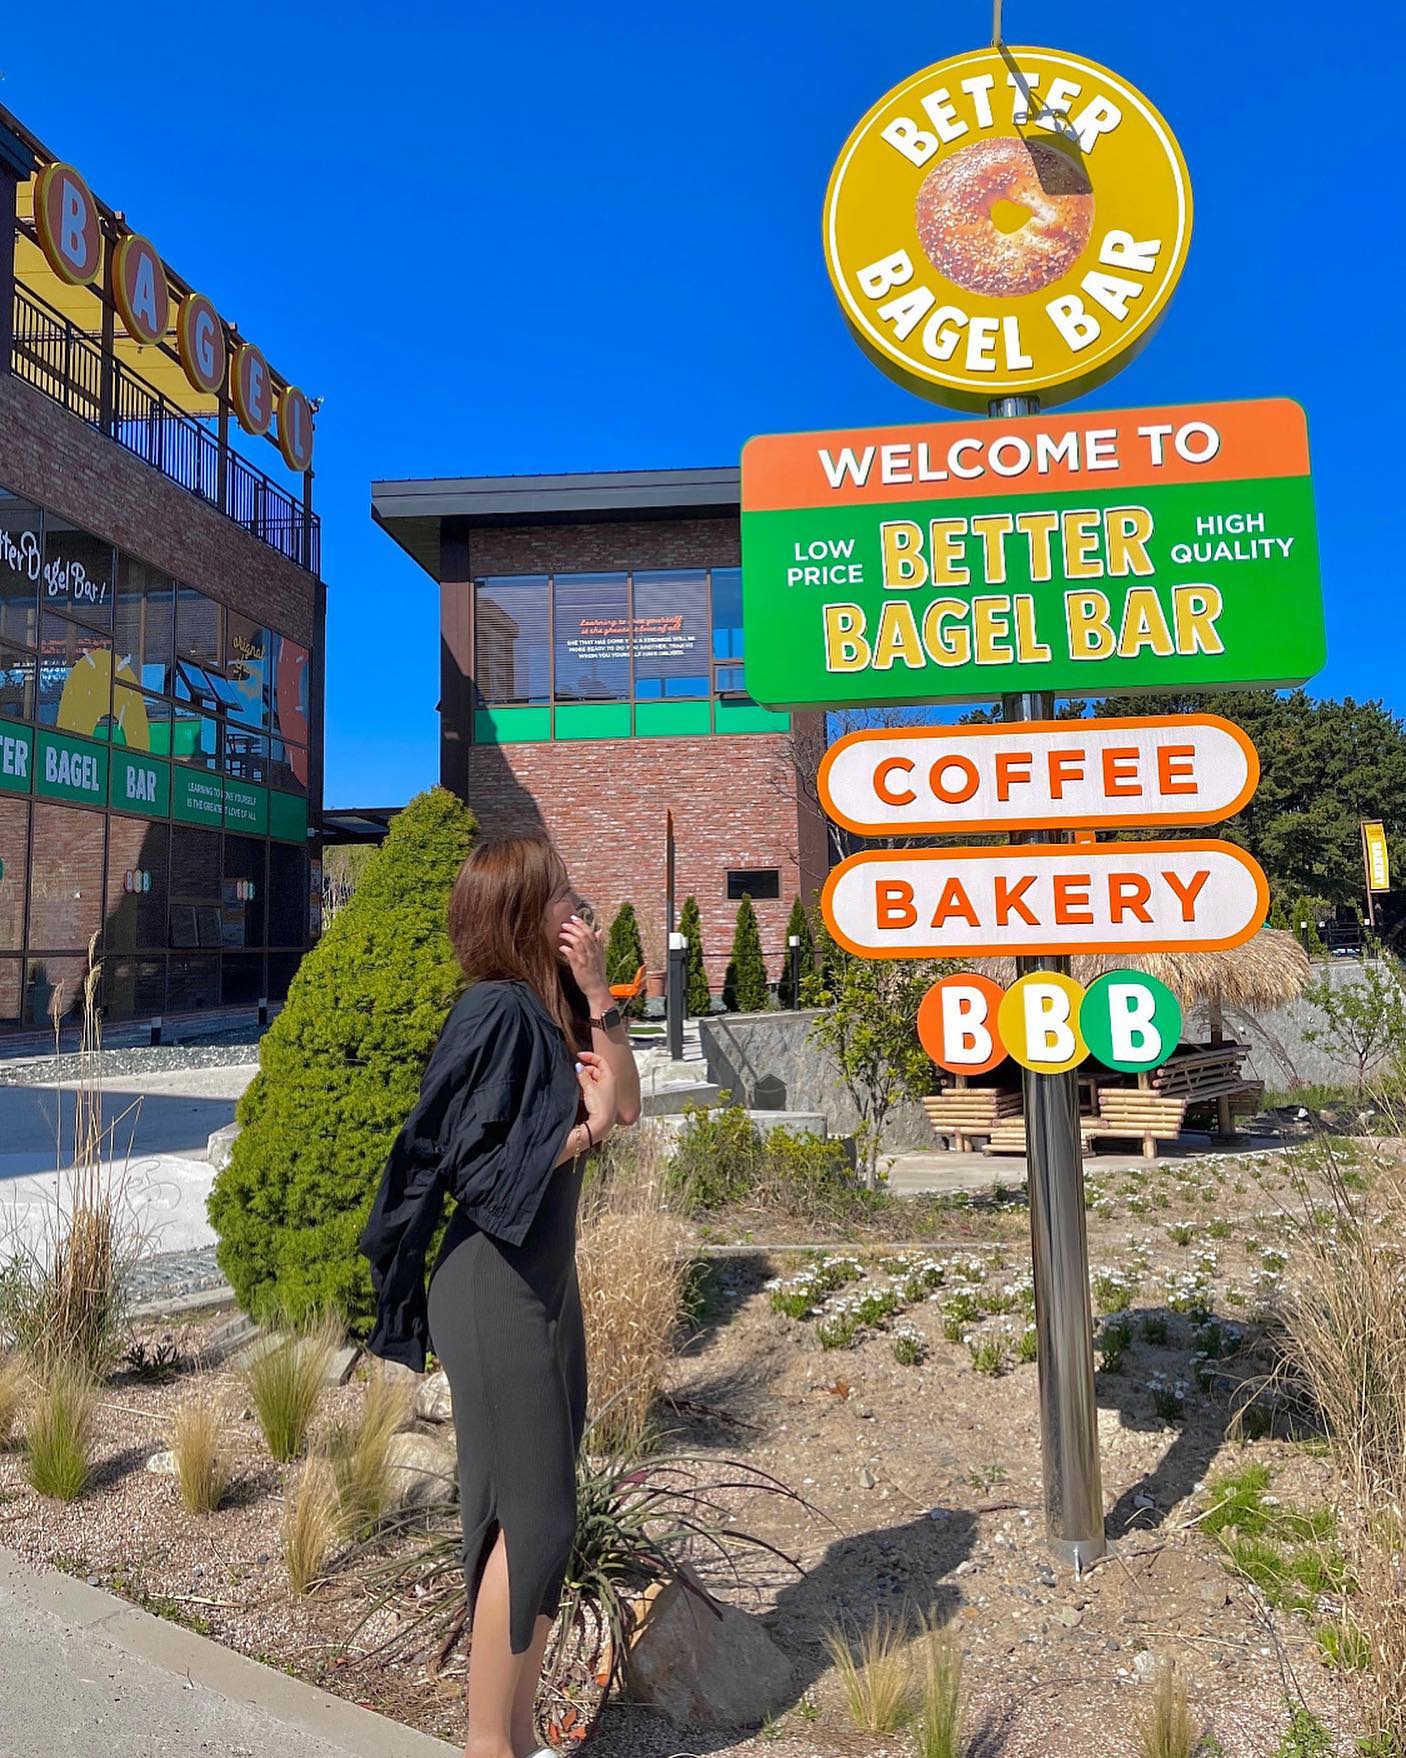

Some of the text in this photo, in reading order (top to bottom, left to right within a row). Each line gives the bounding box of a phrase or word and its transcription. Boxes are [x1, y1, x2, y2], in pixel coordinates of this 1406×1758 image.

[880, 72, 1123, 168] BETTER
[60, 177, 305, 459] BAGEL
[856, 229, 1161, 371] BAGEL BAR
[818, 421, 1220, 488] WELCOME TO
[793, 538, 856, 562] LOW
[879, 505, 1156, 590] BETTER
[1170, 537, 1296, 566] QUALITY
[1196, 513, 1266, 536] HIGH
[786, 563, 864, 587] PRICE
[822, 583, 1225, 674] BAGEL BAR
[45, 746, 100, 792] BAGEL
[126, 765, 157, 802] BAR
[872, 744, 1199, 807] COFFEE
[874, 870, 1211, 930] BAKERY
